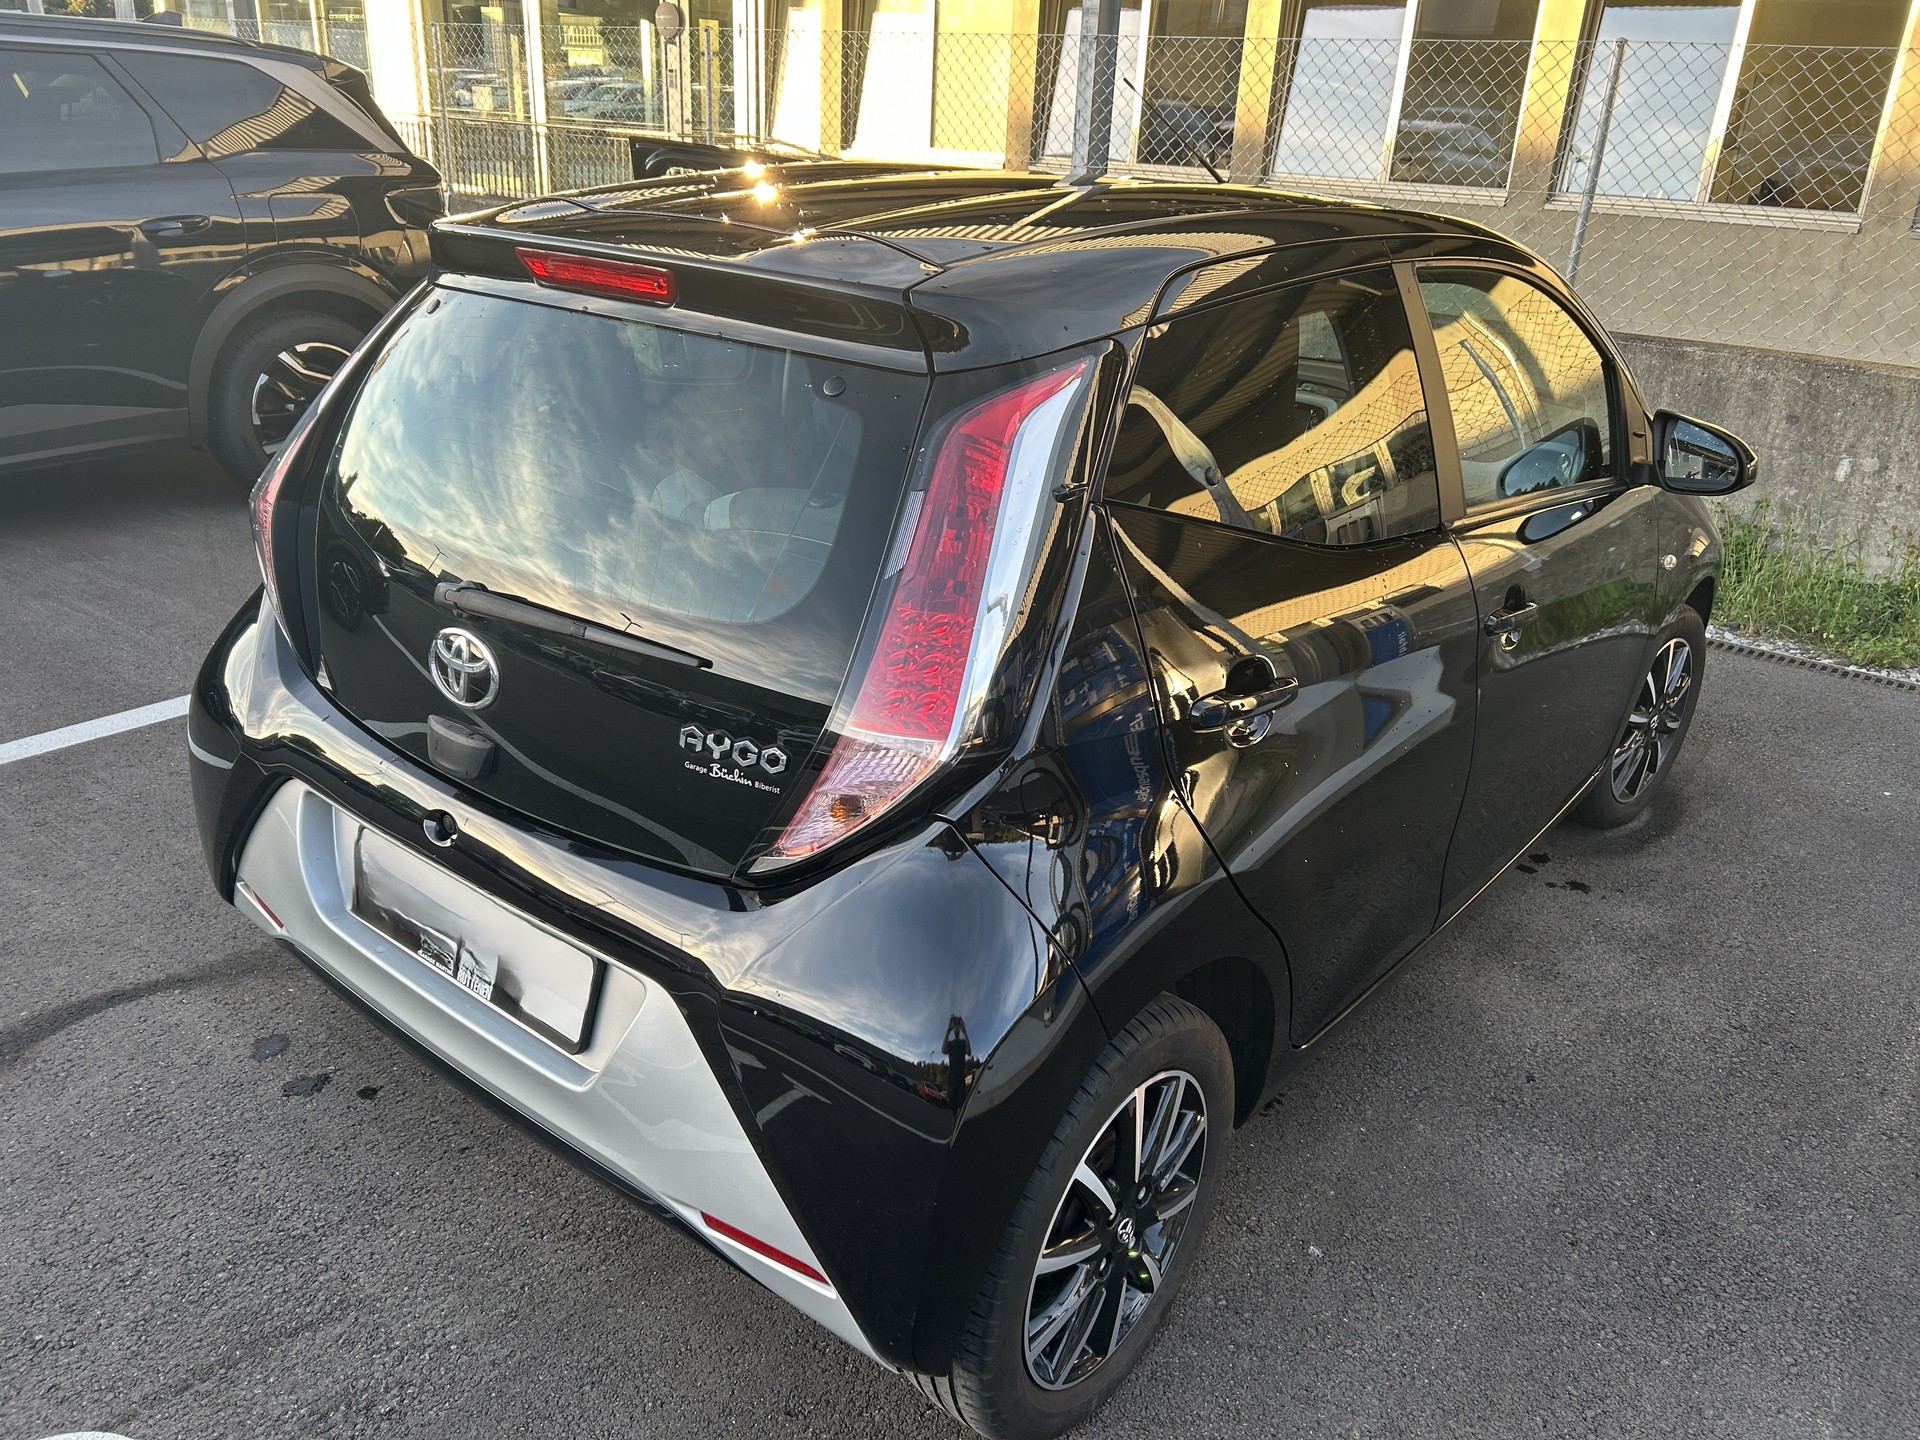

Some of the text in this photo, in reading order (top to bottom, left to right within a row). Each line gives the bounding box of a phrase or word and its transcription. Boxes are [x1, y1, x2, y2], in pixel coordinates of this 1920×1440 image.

[679, 725, 787, 775] AYGO
[684, 761, 708, 774] Garage
[754, 780, 781, 794] Biberist
